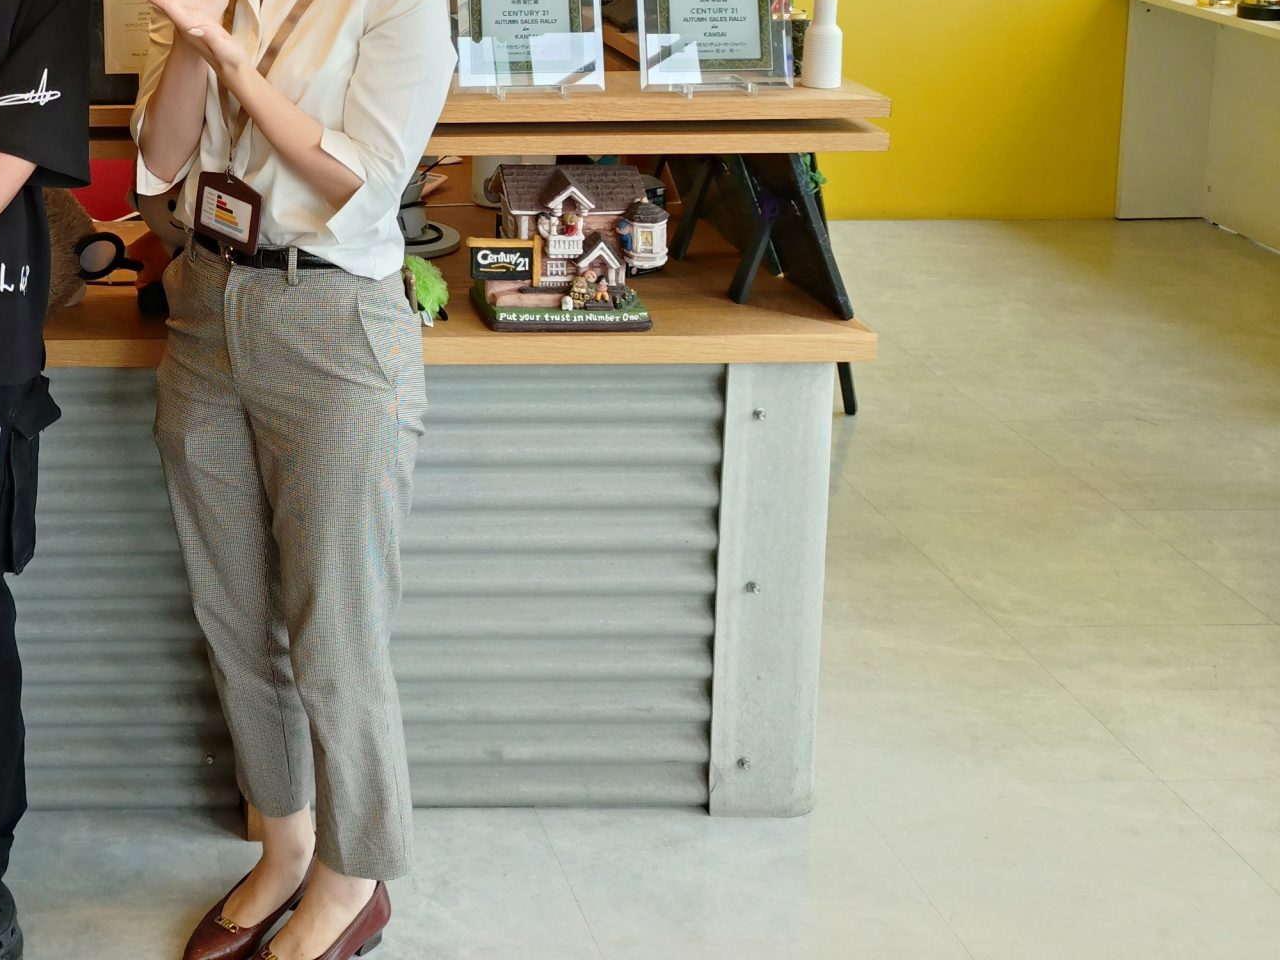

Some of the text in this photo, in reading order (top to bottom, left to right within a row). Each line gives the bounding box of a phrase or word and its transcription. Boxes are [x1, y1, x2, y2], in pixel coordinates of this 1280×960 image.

[477, 250, 529, 271] Century 21
[499, 312, 518, 321] Put
[518, 313, 540, 321] your
[544, 312, 571, 321] trust
[572, 314, 584, 322] in
[585, 313, 621, 322] Number
